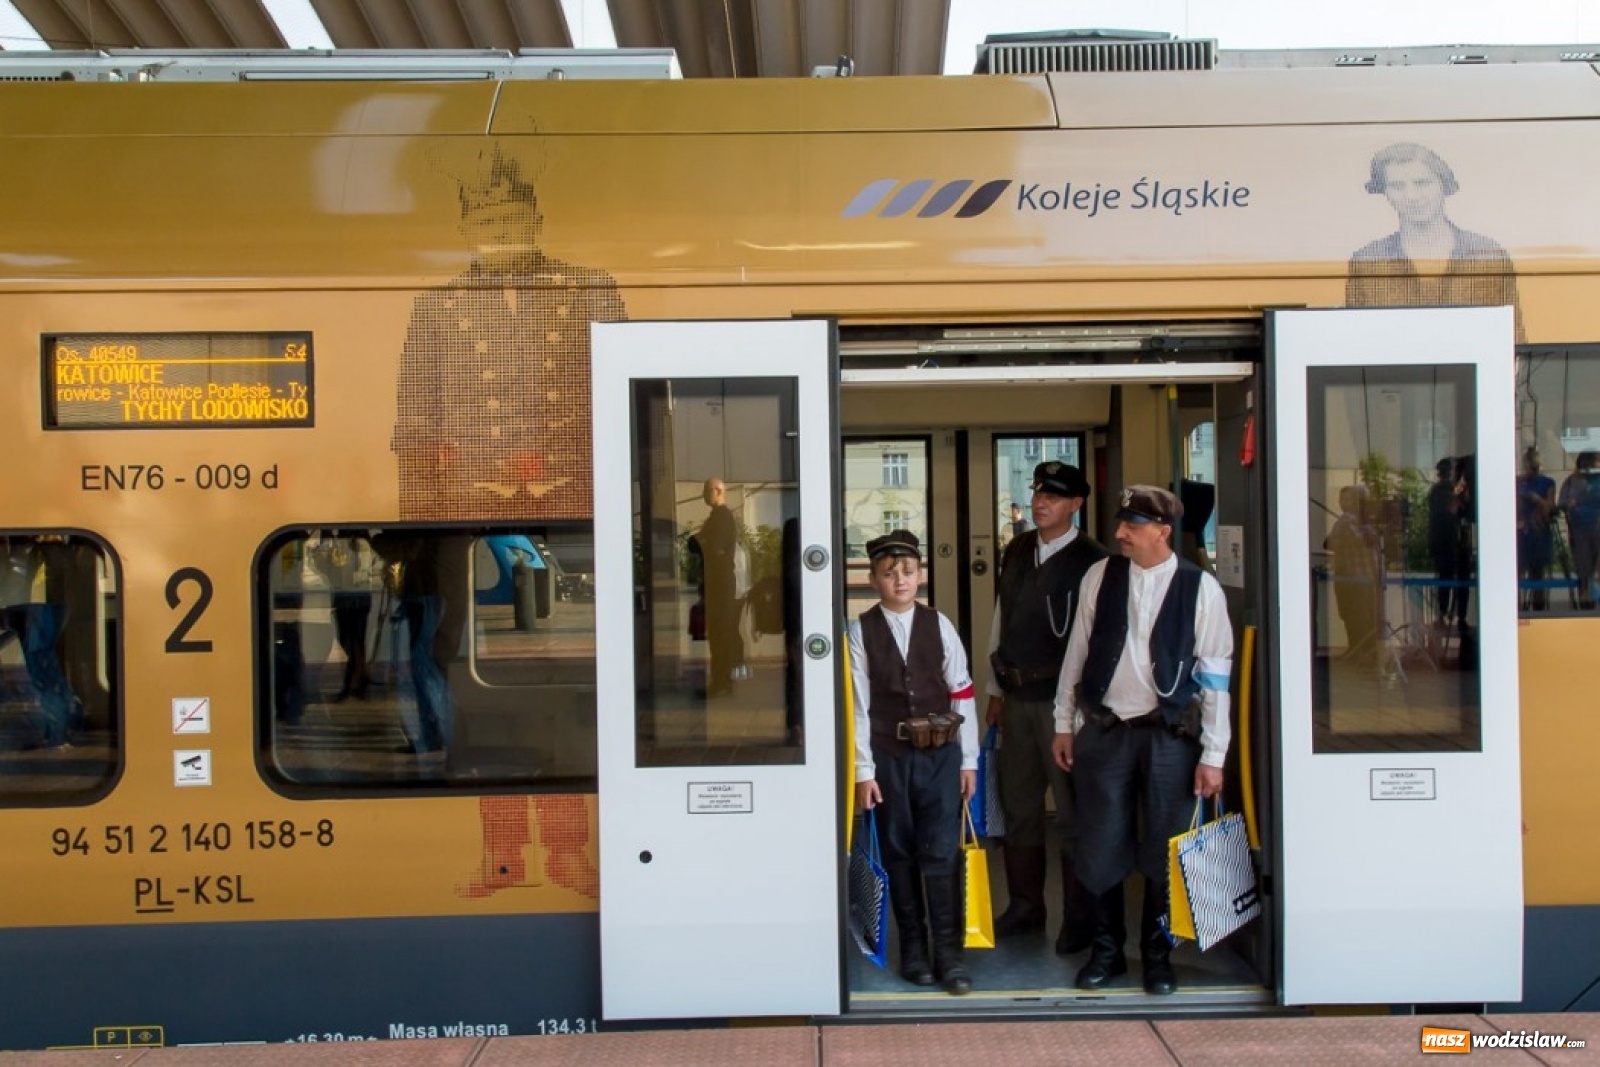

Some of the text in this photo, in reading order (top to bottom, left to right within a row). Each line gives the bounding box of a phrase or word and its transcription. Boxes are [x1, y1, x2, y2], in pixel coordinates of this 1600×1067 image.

[1017, 177, 1251, 217] Koleje Śląskie
[89, 345, 137, 361] 40549
[56, 364, 164, 385] KATOWICE
[57, 385, 111, 401] rowice
[129, 383, 202, 400] Katowice
[208, 382, 271, 399] Podlesie
[288, 382, 308, 398] Ty
[121, 398, 308, 420] TYCHY LODOWISKO
[81, 465, 164, 490] EN76
[196, 465, 251, 489] 009
[261, 464, 278, 489] d
[164, 566, 214, 653] 2
[52, 819, 335, 856] 94 51 2 140 158-8
[135, 875, 254, 905] PL-KSL
[107, 1031, 115, 1042] P
[389, 1021, 509, 1039] Masa własna
[537, 1018, 598, 1035] 134.3 t
